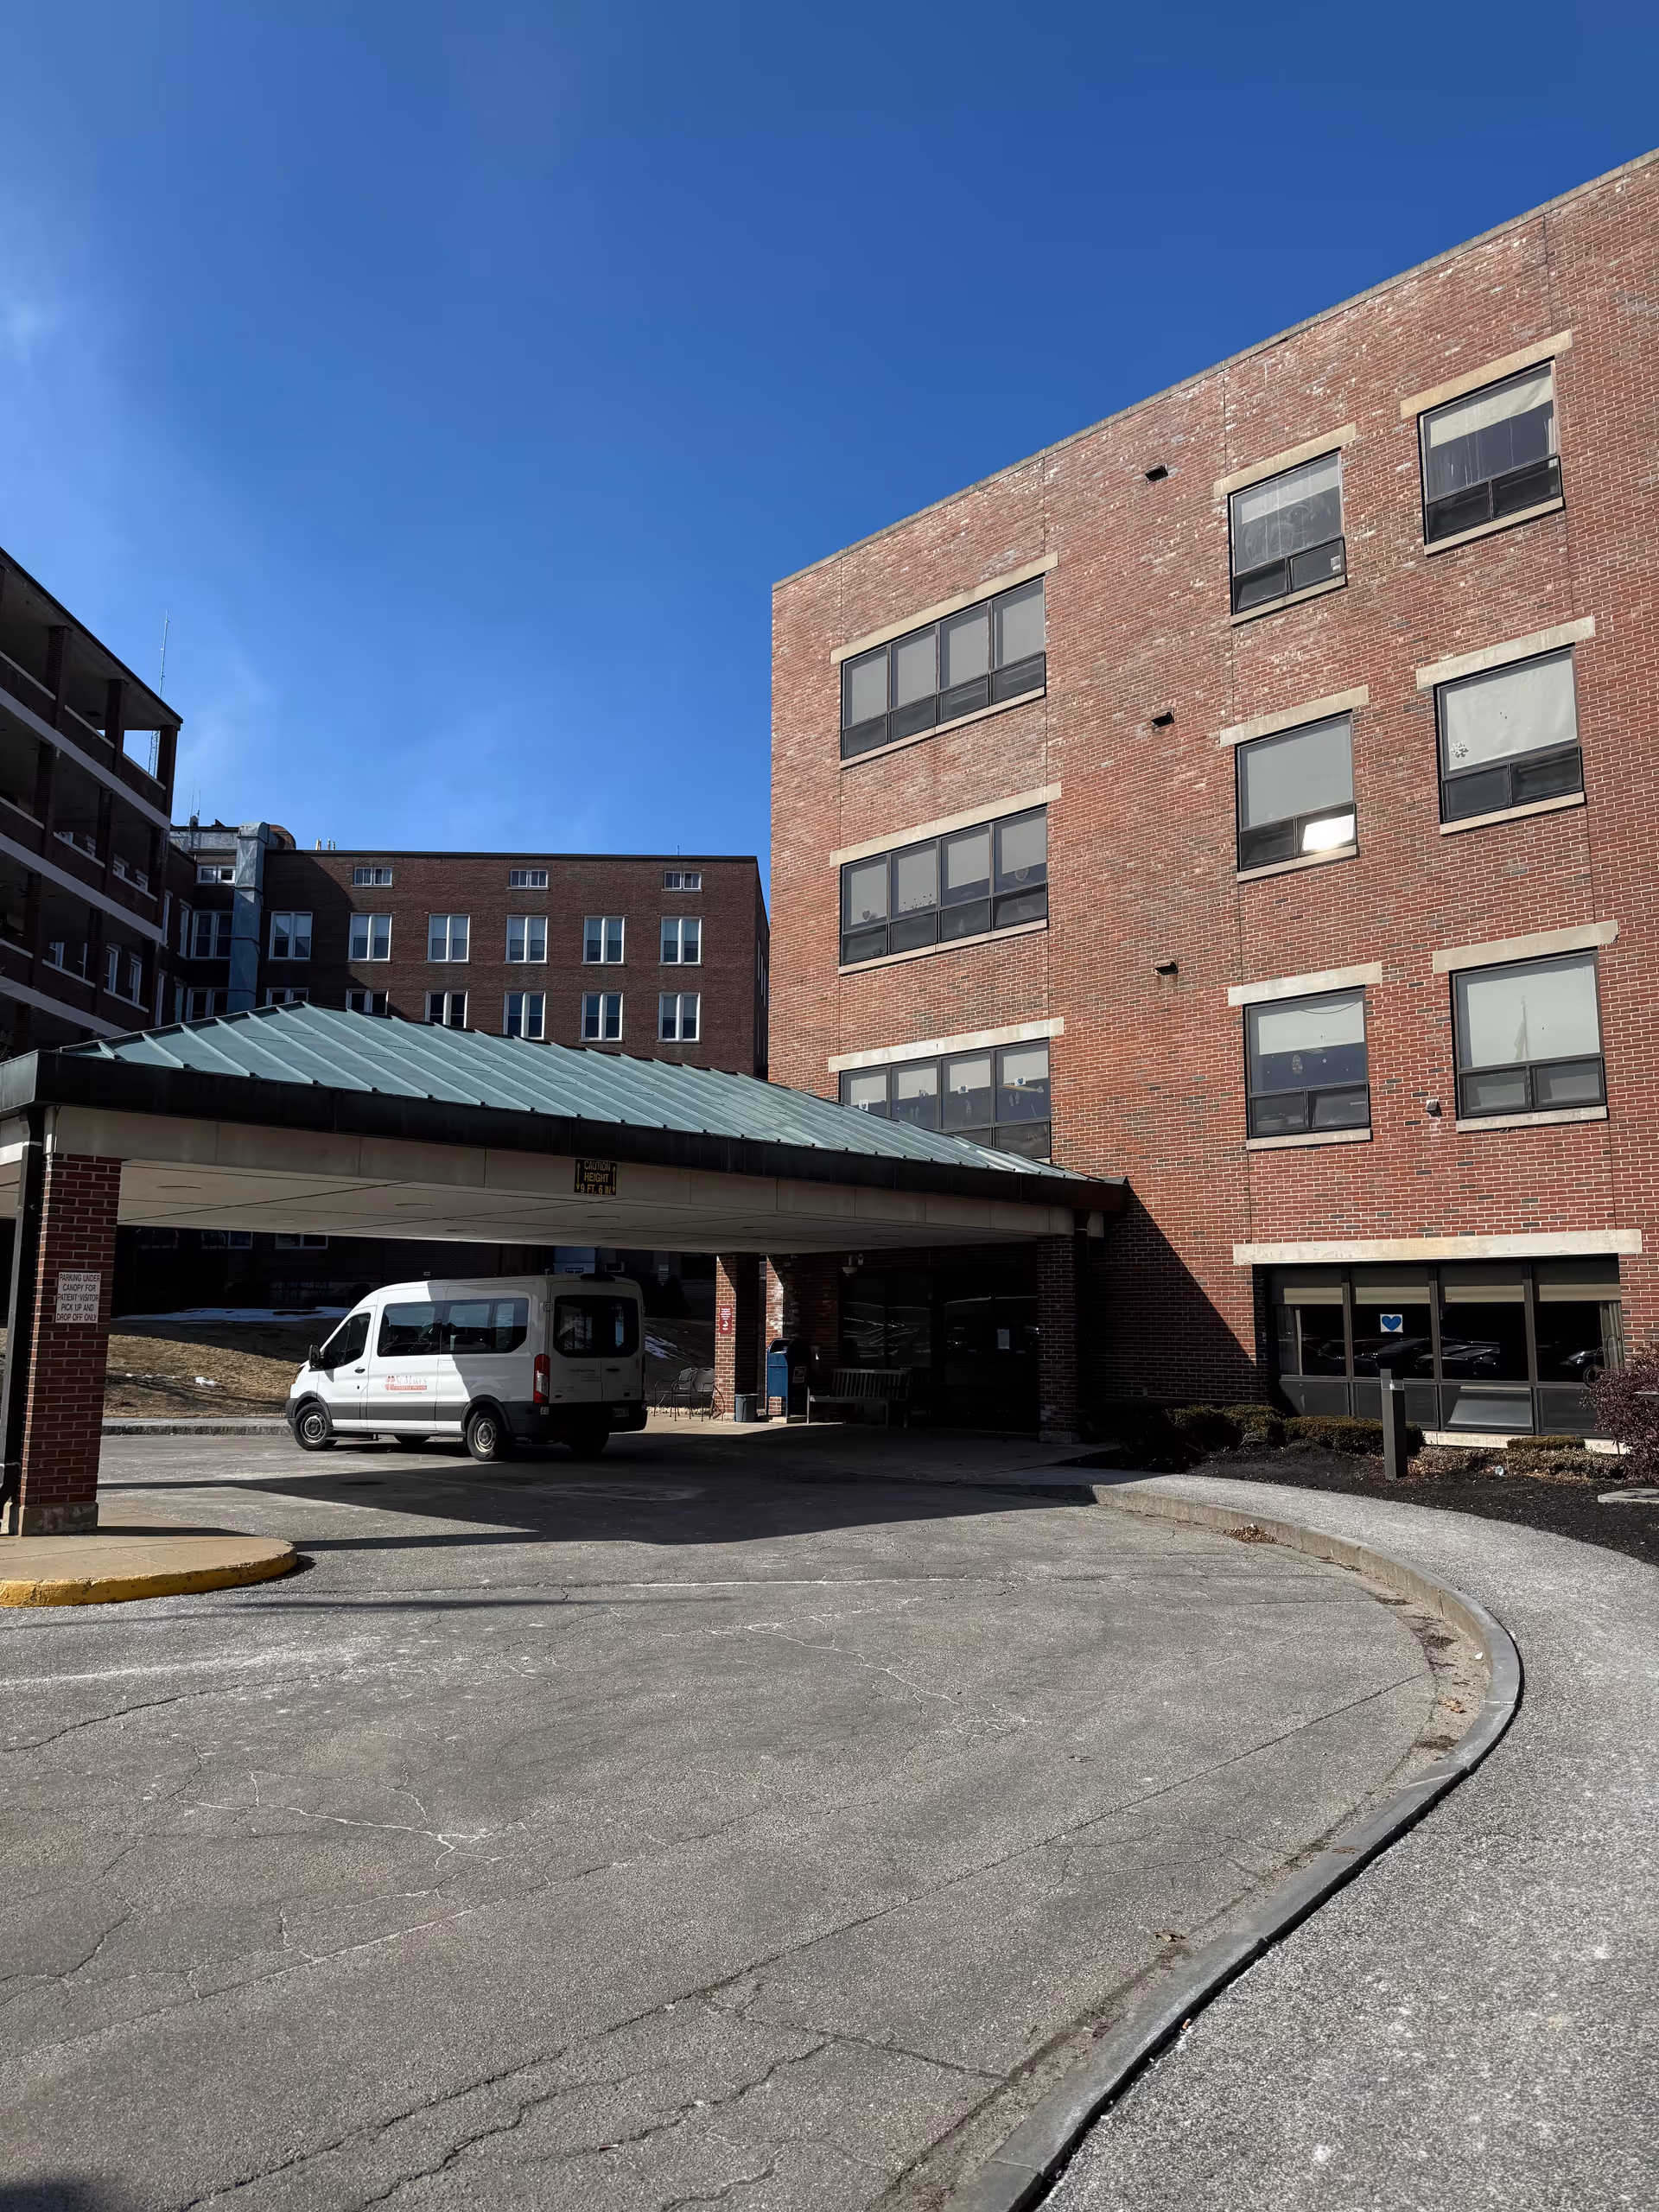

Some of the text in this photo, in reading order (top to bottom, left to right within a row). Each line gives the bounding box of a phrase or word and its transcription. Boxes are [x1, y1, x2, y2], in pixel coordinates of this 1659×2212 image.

[584, 1160, 611, 1172] CAUTION
[584, 1172, 609, 1182] HEIGHT
[581, 1184, 585, 1192] 9
[599, 1185, 603, 1194] 6
[61, 1303, 73, 1312] PICK
